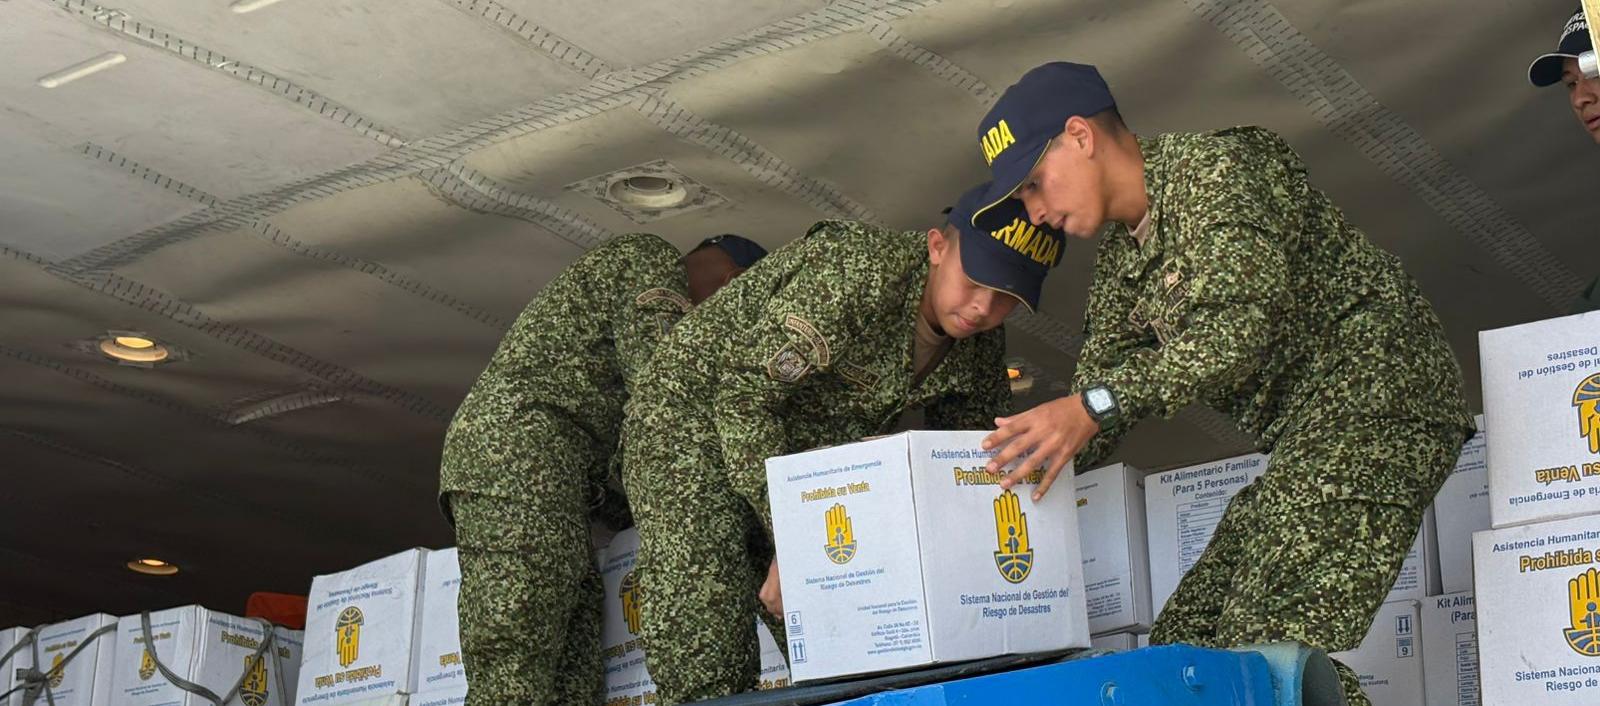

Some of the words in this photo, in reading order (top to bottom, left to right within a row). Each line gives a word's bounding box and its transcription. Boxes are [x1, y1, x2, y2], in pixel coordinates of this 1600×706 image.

[1547, 346, 1598, 361] Desastres
[1537, 363, 1576, 377] Gestión
[1578, 360, 1591, 368] de
[1518, 368, 1534, 380] del
[931, 448, 970, 459] Asistencia
[851, 460, 882, 471] Emergencia
[1160, 473, 1173, 484] Kit
[1174, 464, 1223, 482] Alimentario
[1225, 458, 1261, 472] Familiar
[1535, 465, 1581, 486] Venta
[801, 486, 836, 503] Prohibida
[836, 486, 848, 496] su
[847, 480, 871, 494] Venta
[1172, 482, 1196, 497] (Para
[1197, 480, 1204, 491] 5
[1204, 472, 1249, 490] Personas)
[1508, 491, 1570, 505] Emergencia
[1573, 488, 1586, 499] de
[1493, 537, 1545, 553] Asistencia
[1547, 529, 1600, 545] Humanitar
[1519, 548, 1593, 573] Prohibida
[960, 594, 991, 605] Sistema
[992, 590, 1021, 602] Nacional
[1022, 590, 1031, 601] de
[1032, 588, 1058, 600] Gestión
[1058, 587, 1069, 598] del
[1437, 598, 1451, 609] Kit
[1452, 596, 1474, 607] Alim
[982, 607, 1008, 619] Riesgo
[1008, 606, 1017, 615] de
[1018, 603, 1052, 615] Desastres
[790, 614, 797, 624] 6
[1515, 669, 1556, 682] Sistema
[1558, 665, 1600, 677] Naciona
[1546, 679, 1582, 692] Riesgo
[1585, 677, 1597, 688] de
